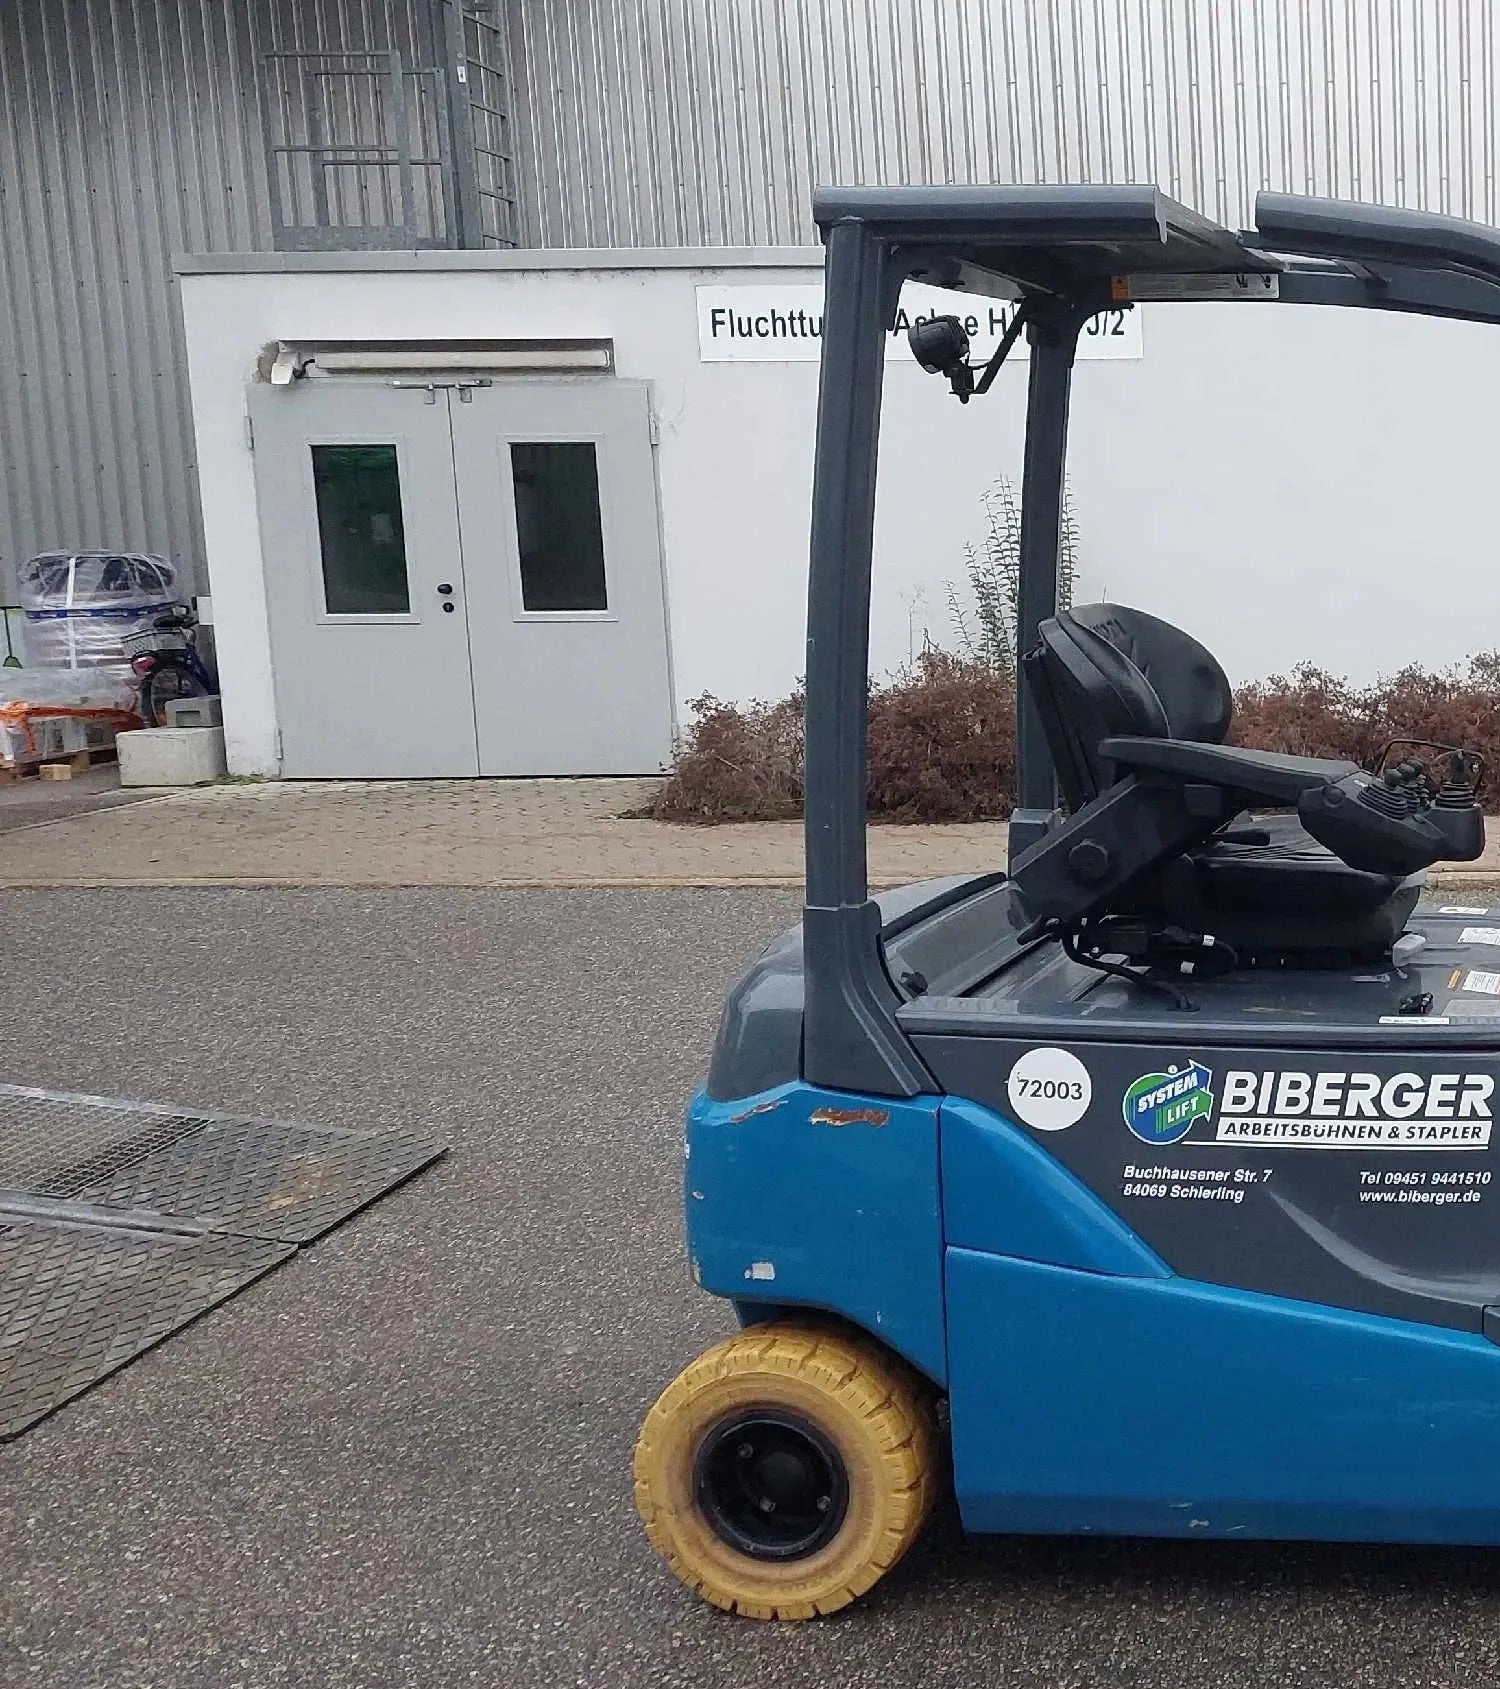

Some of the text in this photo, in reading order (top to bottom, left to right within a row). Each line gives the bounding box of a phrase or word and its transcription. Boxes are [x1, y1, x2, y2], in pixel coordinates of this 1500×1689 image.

[711, 308, 823, 337] Fluchttu
[1017, 1079, 1083, 1100] 72003
[1138, 1071, 1199, 1113] SYSTEM
[1220, 1071, 1495, 1118] BIBERGER
[1167, 1095, 1199, 1124] LIFT
[1224, 1122, 1483, 1139] ARBEITSBÜHNEN & STAPLER
[1123, 1165, 1273, 1183] Buchhausener Str. 7
[1359, 1171, 1492, 1185] Tel 09451 9441510
[1123, 1183, 1245, 1204] 84069 Schierling
[1359, 1189, 1481, 1205] www.biberger.de
